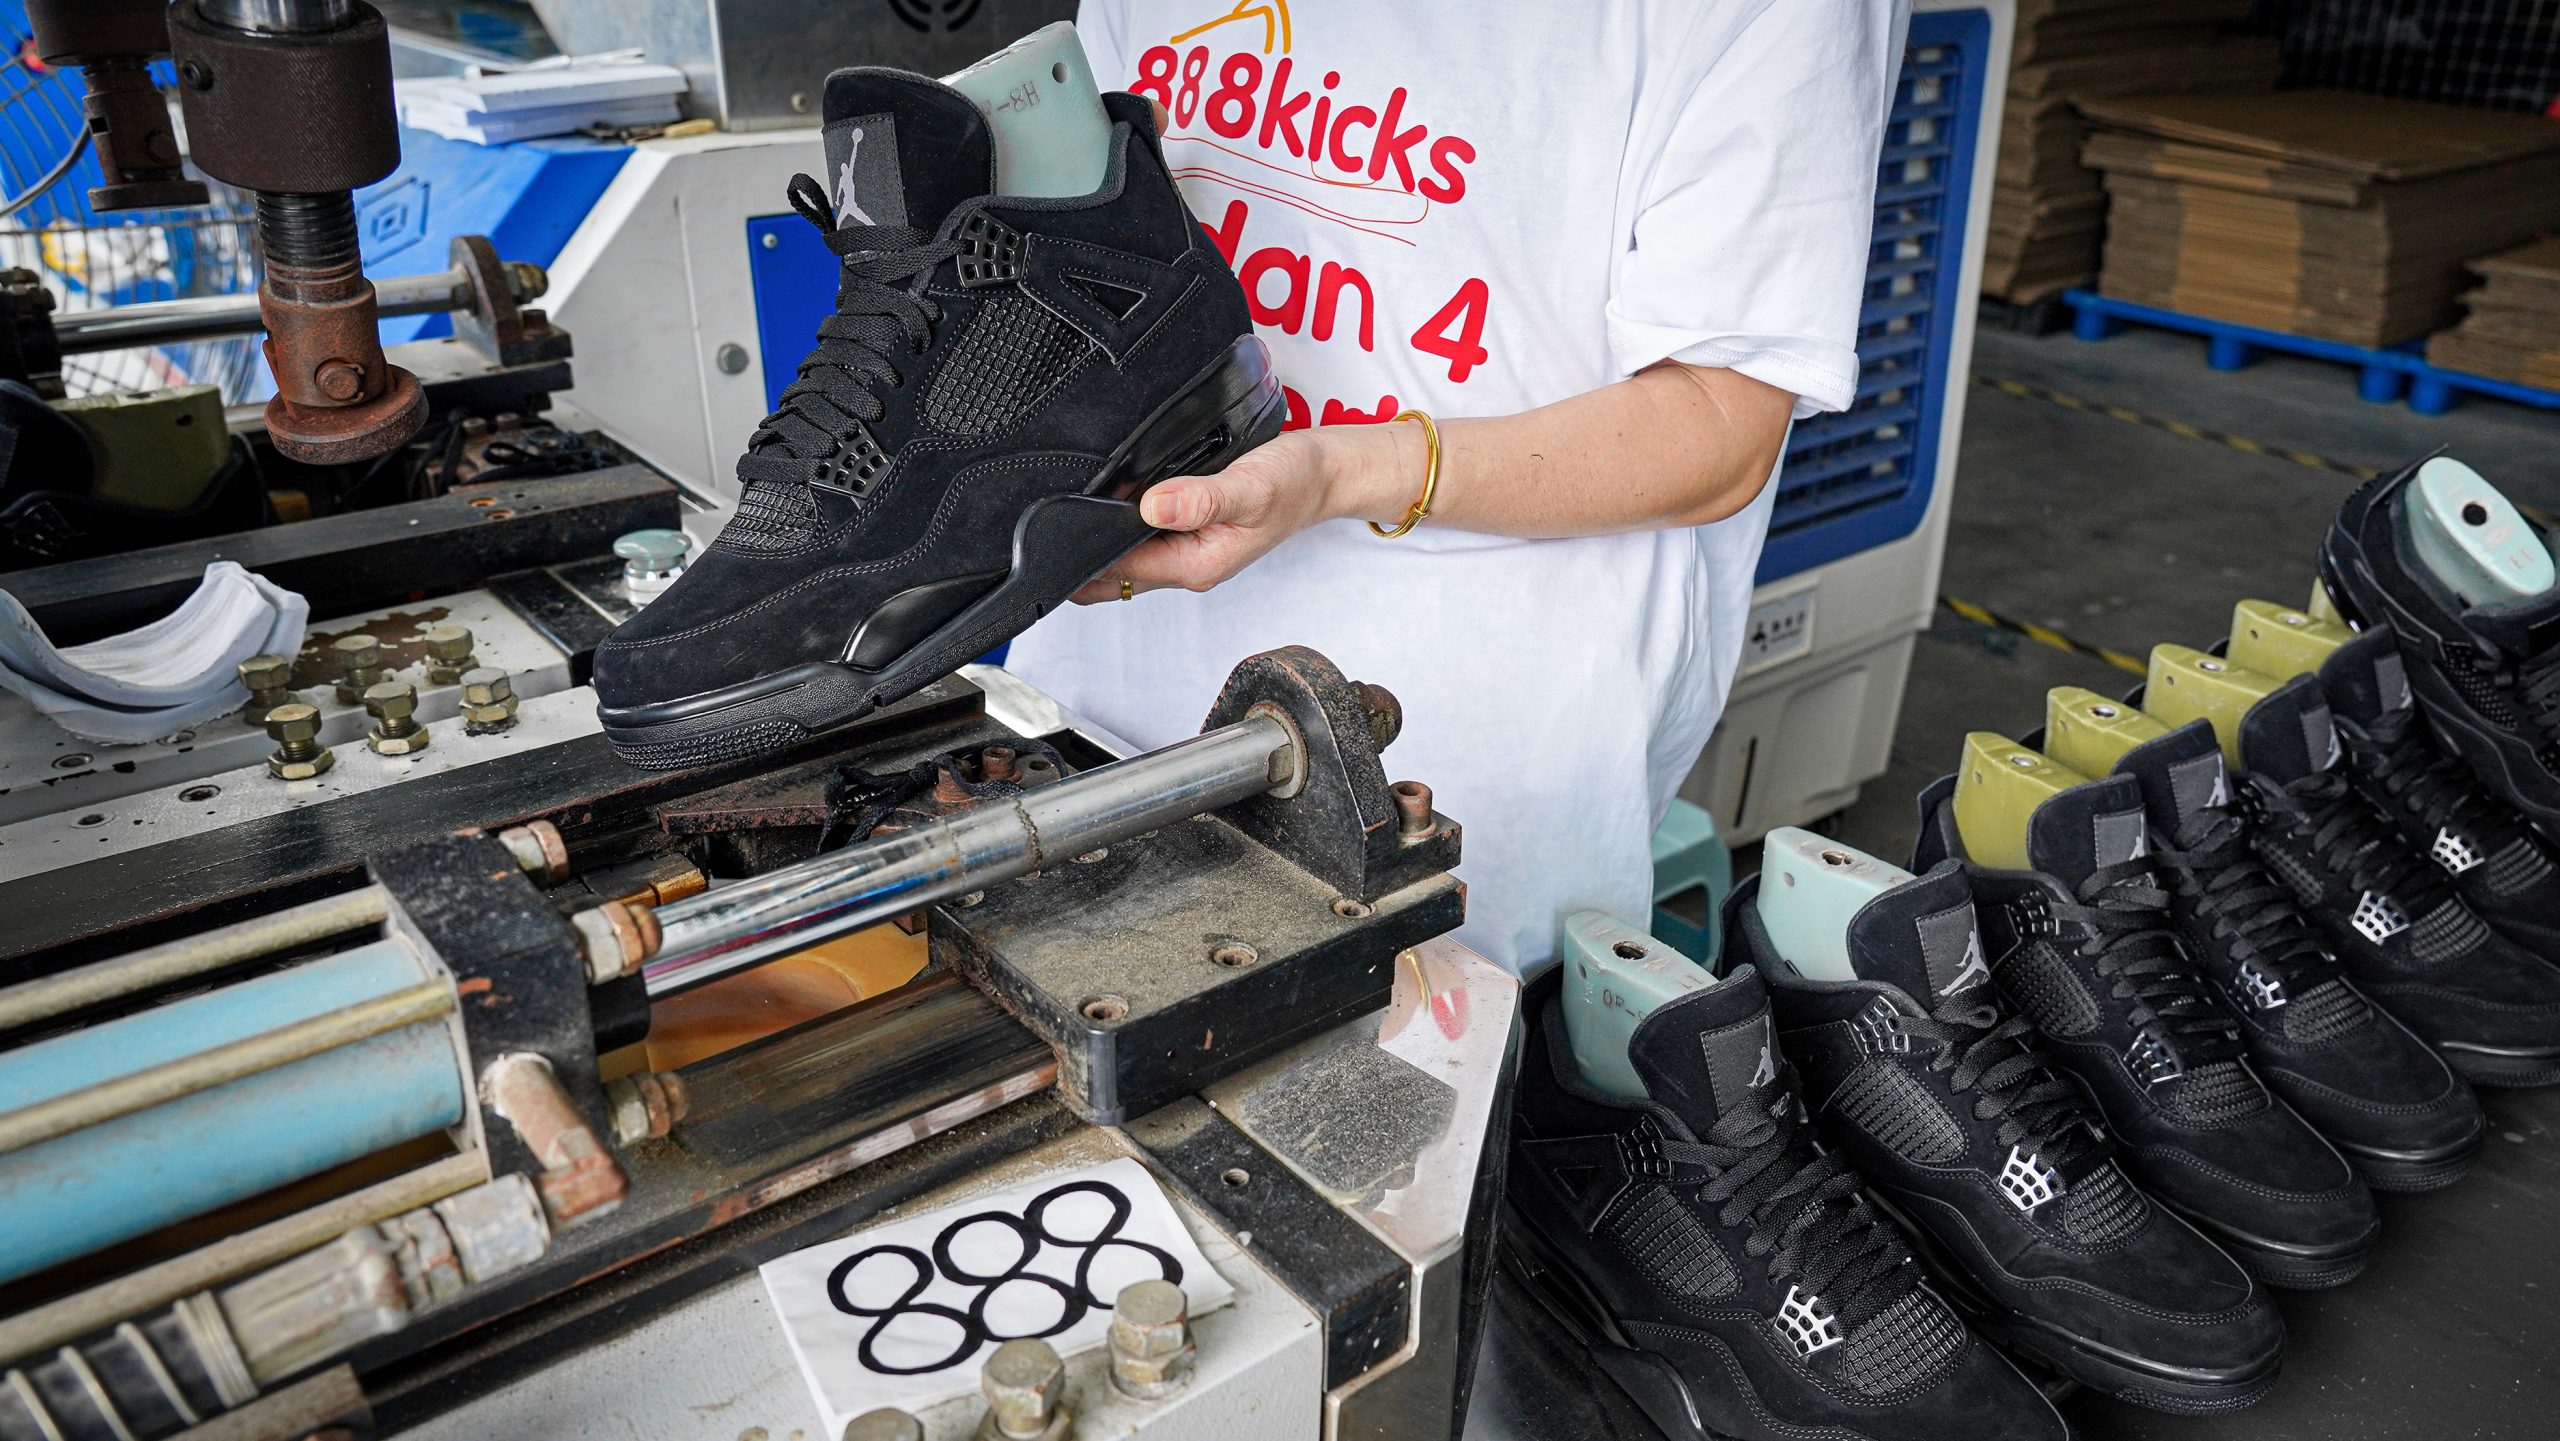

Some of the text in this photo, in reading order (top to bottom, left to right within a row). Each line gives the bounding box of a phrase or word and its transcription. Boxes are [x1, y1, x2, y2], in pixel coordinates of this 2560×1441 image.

[1126, 46, 1476, 204] 888kicks
[1410, 277, 1489, 383] 4
[826, 1179, 1184, 1376] 888
